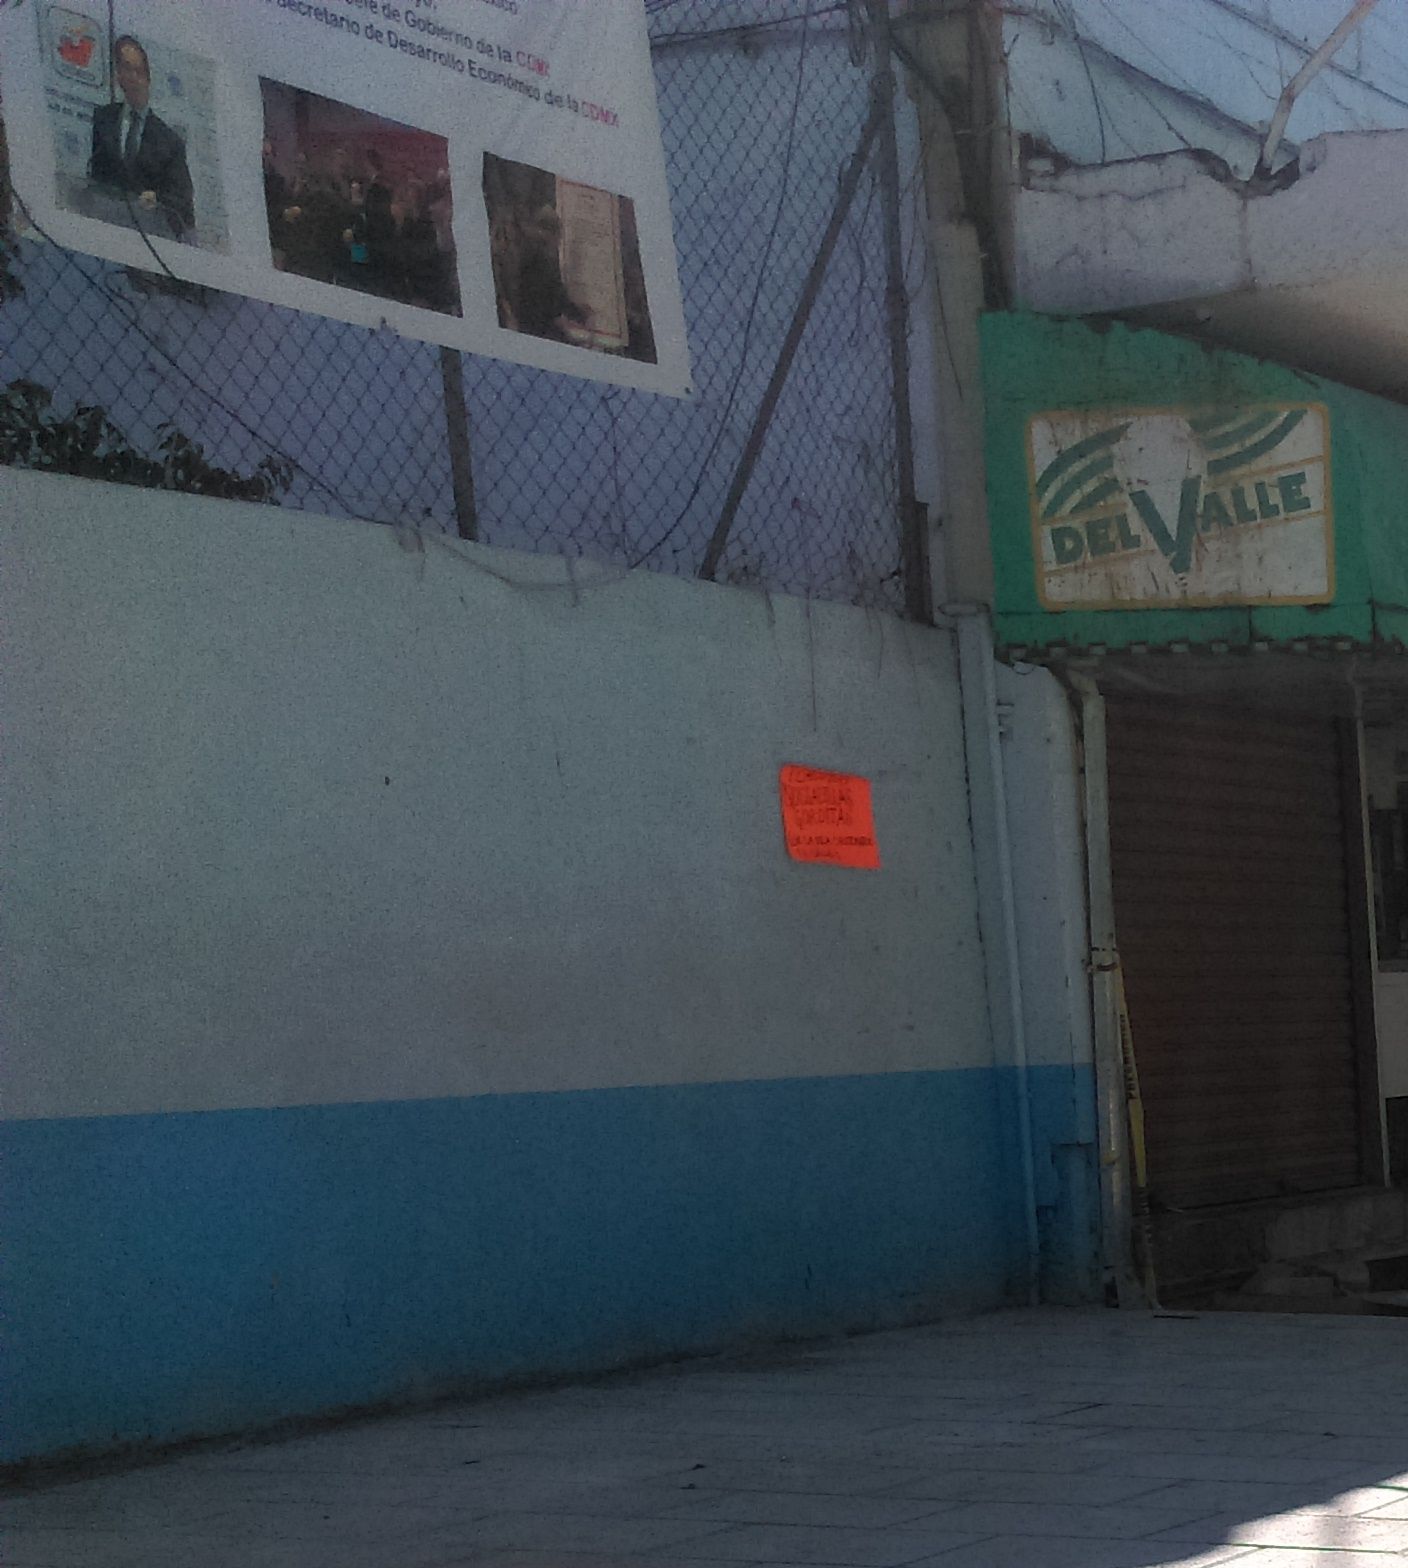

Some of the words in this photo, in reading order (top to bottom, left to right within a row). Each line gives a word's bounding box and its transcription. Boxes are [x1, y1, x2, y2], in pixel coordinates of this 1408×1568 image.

[345, 0, 380, 14] efe
[382, 3, 401, 22] de
[404, 9, 473, 50] Gobierno
[476, 37, 495, 59] de
[497, 46, 513, 64] la
[364, 23, 384, 44] de
[387, 29, 466, 74] Desarrollo
[543, 89, 564, 109] de
[566, 93, 579, 113] la
[1051, 513, 1142, 566] DEL
[1128, 470, 1312, 575] VALLE
